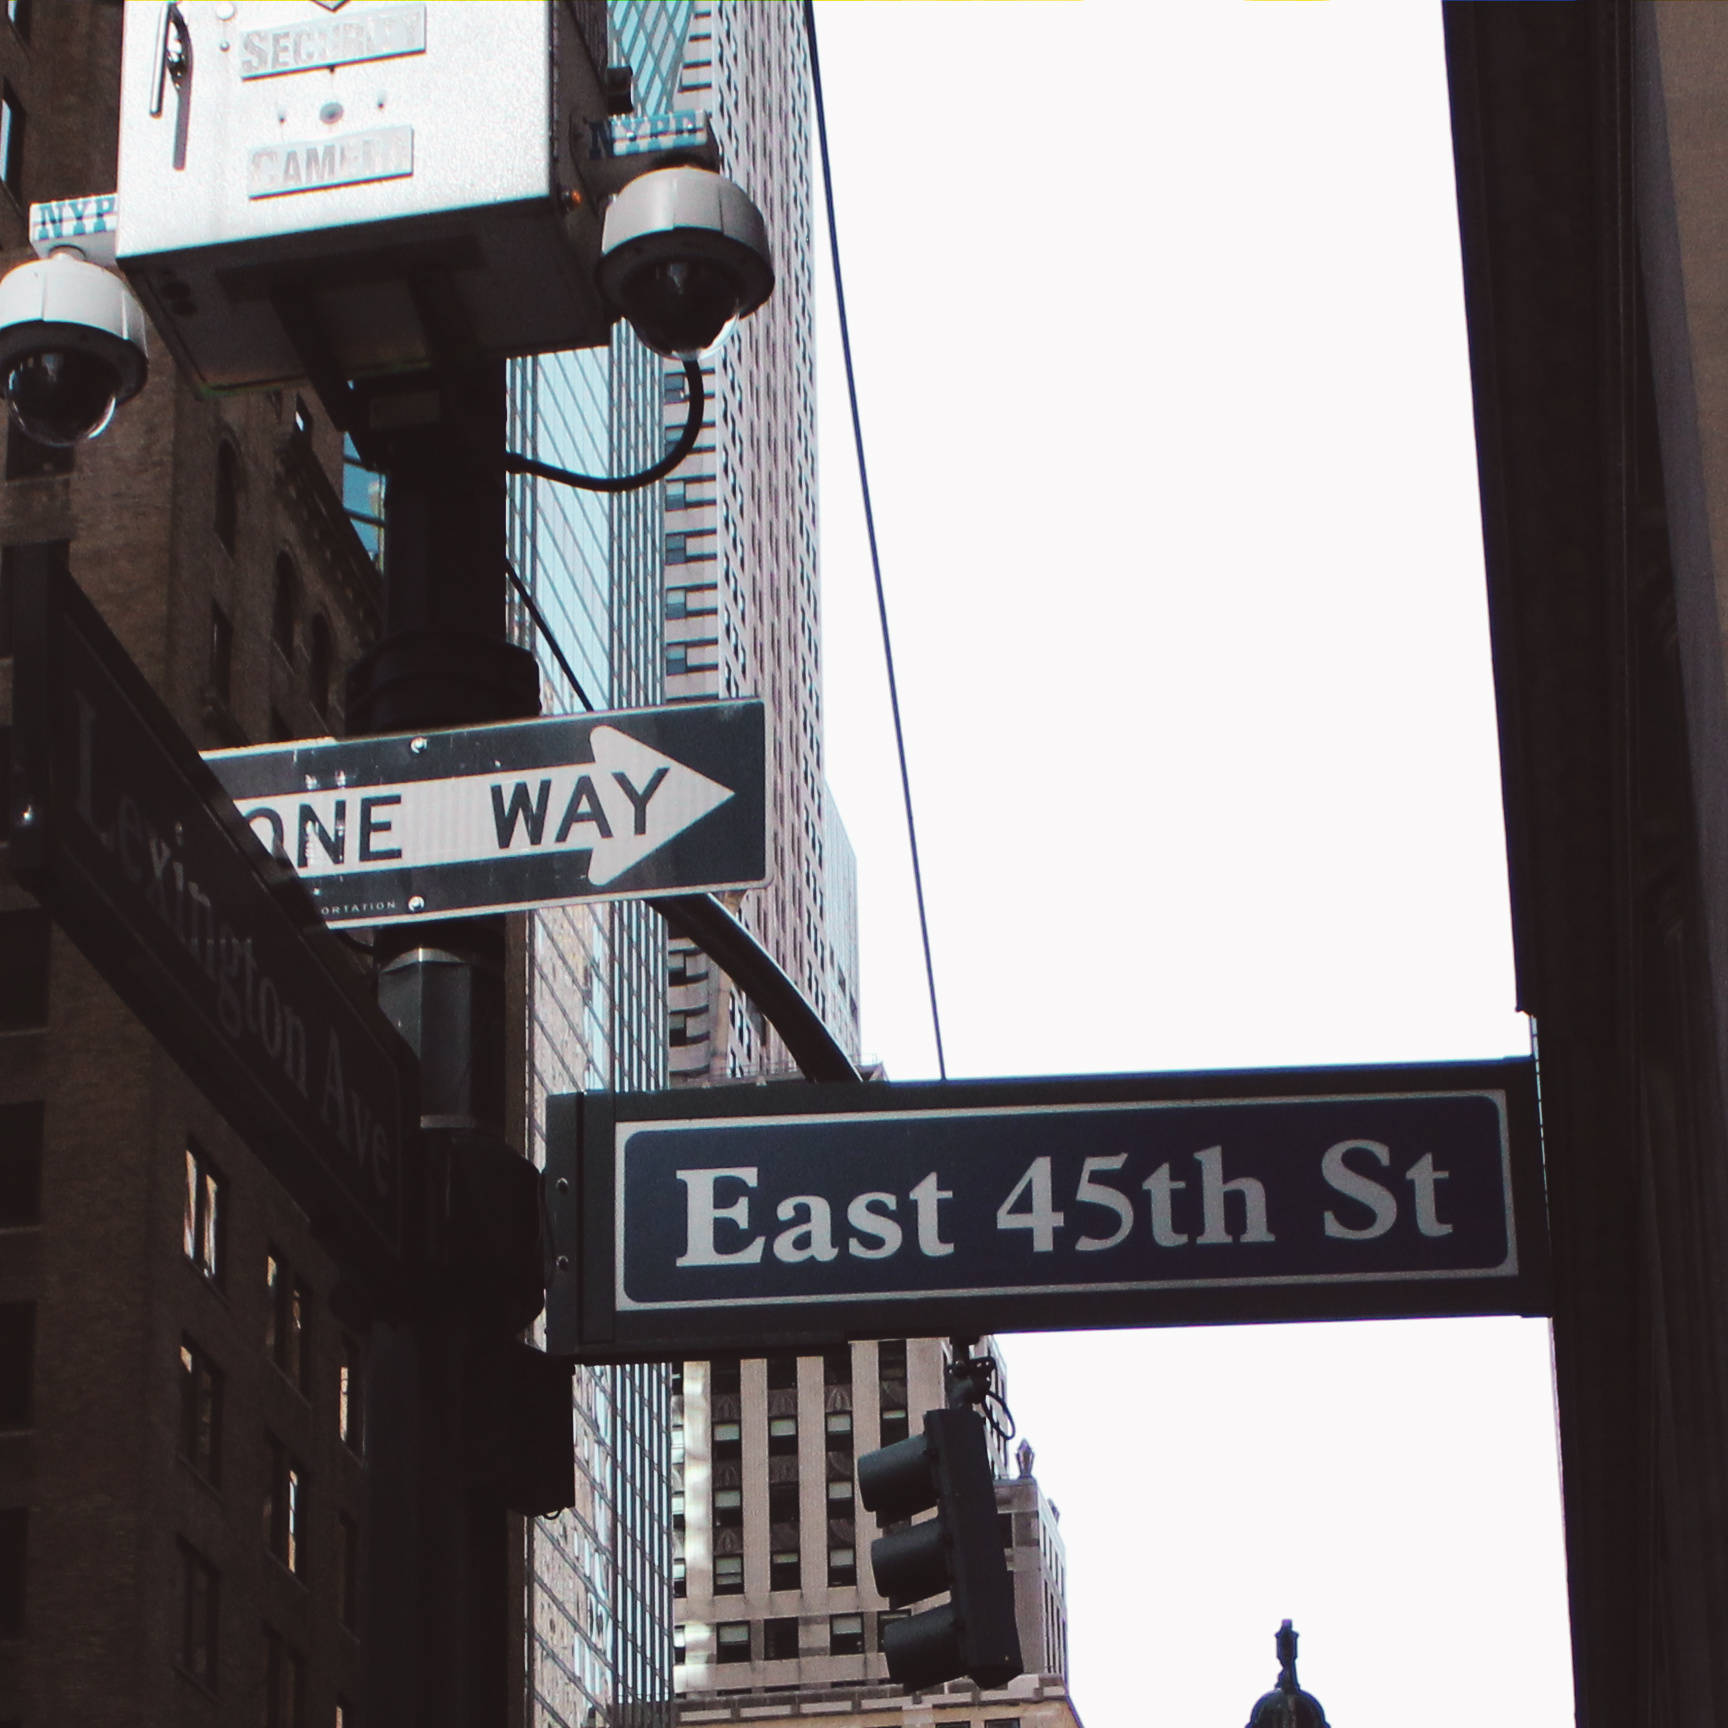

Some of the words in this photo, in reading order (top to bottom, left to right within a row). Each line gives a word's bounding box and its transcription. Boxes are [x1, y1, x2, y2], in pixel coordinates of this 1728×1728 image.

[491, 765, 671, 850] WAY
[71, 688, 310, 1100] Lexington
[319, 1024, 393, 1197] Ave
[675, 1165, 955, 1268] East
[996, 1145, 1277, 1253] 45th
[1320, 1136, 1456, 1241] St
